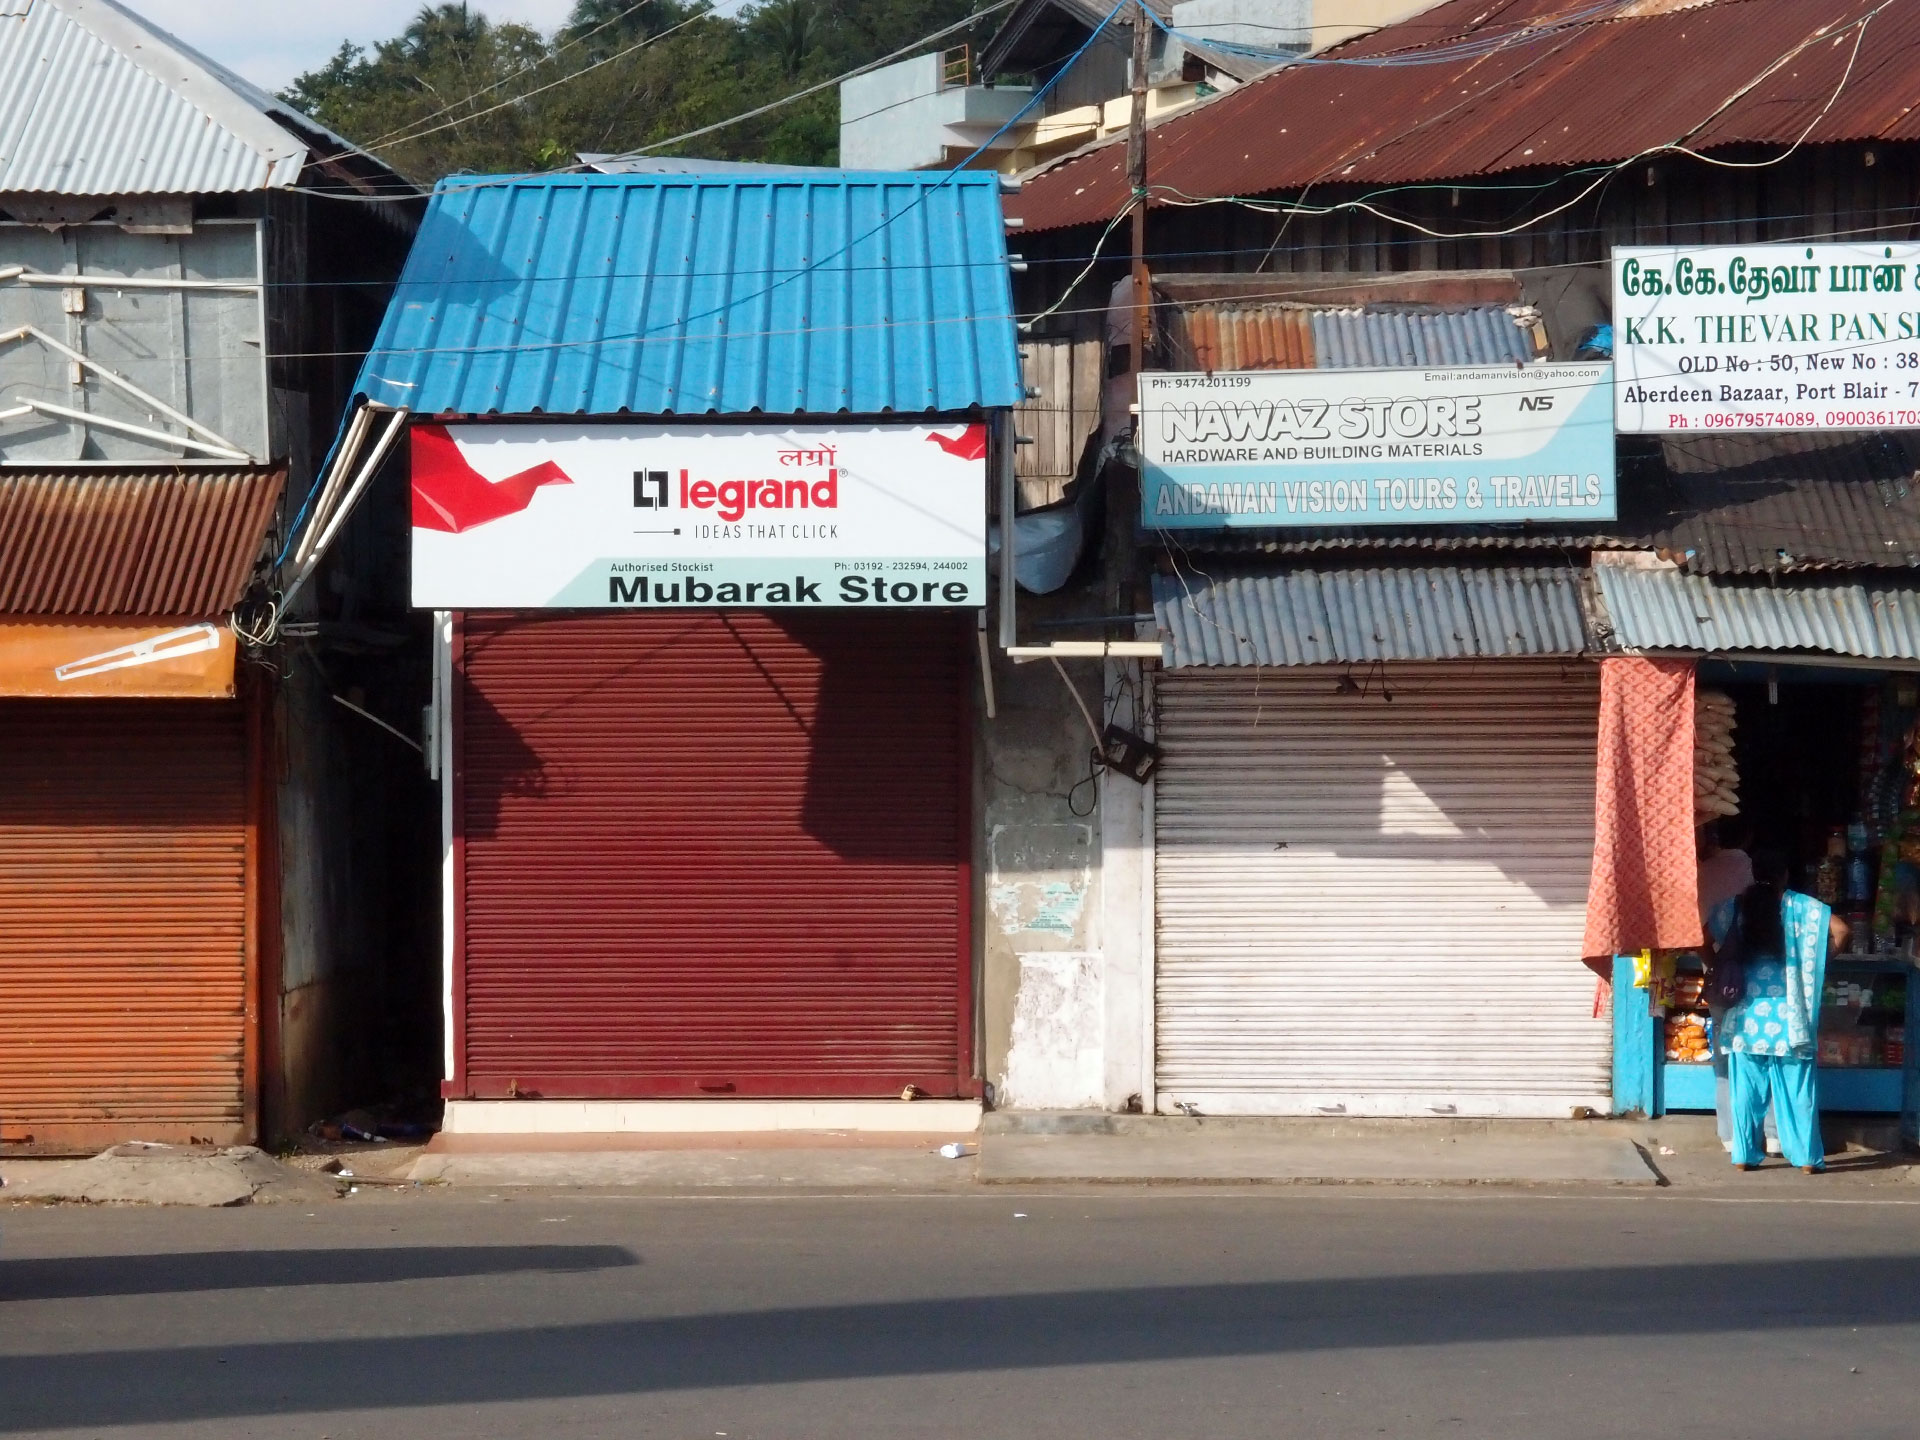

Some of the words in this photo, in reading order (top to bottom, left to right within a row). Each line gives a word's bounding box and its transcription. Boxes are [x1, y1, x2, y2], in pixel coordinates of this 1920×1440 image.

[1622, 247, 1821, 305] கே.கே.தேவர்
[1828, 246, 1907, 292] பான்
[1624, 316, 1685, 345] K.K.
[1694, 314, 1821, 344] THEVAR
[1829, 312, 1888, 341] PAN
[1678, 355, 1718, 373] OLD
[1725, 355, 1750, 372] No
[1769, 354, 1799, 374] 50,
[1806, 354, 1845, 371] New
[1852, 353, 1876, 370] No
[1896, 351, 1919, 369] 38
[1152, 378, 1172, 389] Ph:
[1175, 377, 1251, 388] 9474201199
[1424, 369, 1600, 382] Email:andamanvision@yahoo.com
[1624, 385, 1712, 403] Aberdeen
[1719, 384, 1789, 404] Bazaar,
[1796, 383, 1836, 400] Port
[1843, 382, 1888, 399] Blair
[1518, 396, 1554, 412] NS
[1161, 398, 1331, 443] NAWAZ
[1338, 395, 1482, 440] STORE
[1668, 413, 1688, 428] Ph
[1704, 412, 1819, 429] 09679574089,
[777, 442, 837, 467] लग्रों
[1162, 448, 1258, 463] HARDWARE
[1263, 447, 1298, 461] AND
[1304, 445, 1382, 460] BUILDING
[1388, 443, 1483, 458] MATERIALS
[1156, 481, 1277, 516] ANDAMAN
[1283, 479, 1368, 514] VISION
[1374, 477, 1457, 511] TOURS
[1465, 476, 1483, 510] &
[1490, 474, 1602, 508] TRAVELS
[695, 524, 742, 539] IDEAS
[749, 524, 785, 539] THAT
[792, 524, 838, 539] CLICK
[610, 562, 668, 572] Authorised
[671, 562, 714, 572] Stockist
[834, 562, 851, 571] Ph:
[854, 562, 883, 571] 03192
[892, 562, 930, 573] 232594,
[933, 561, 968, 571] 244002
[609, 576, 822, 603] Mubarak
[839, 576, 969, 603] Store
